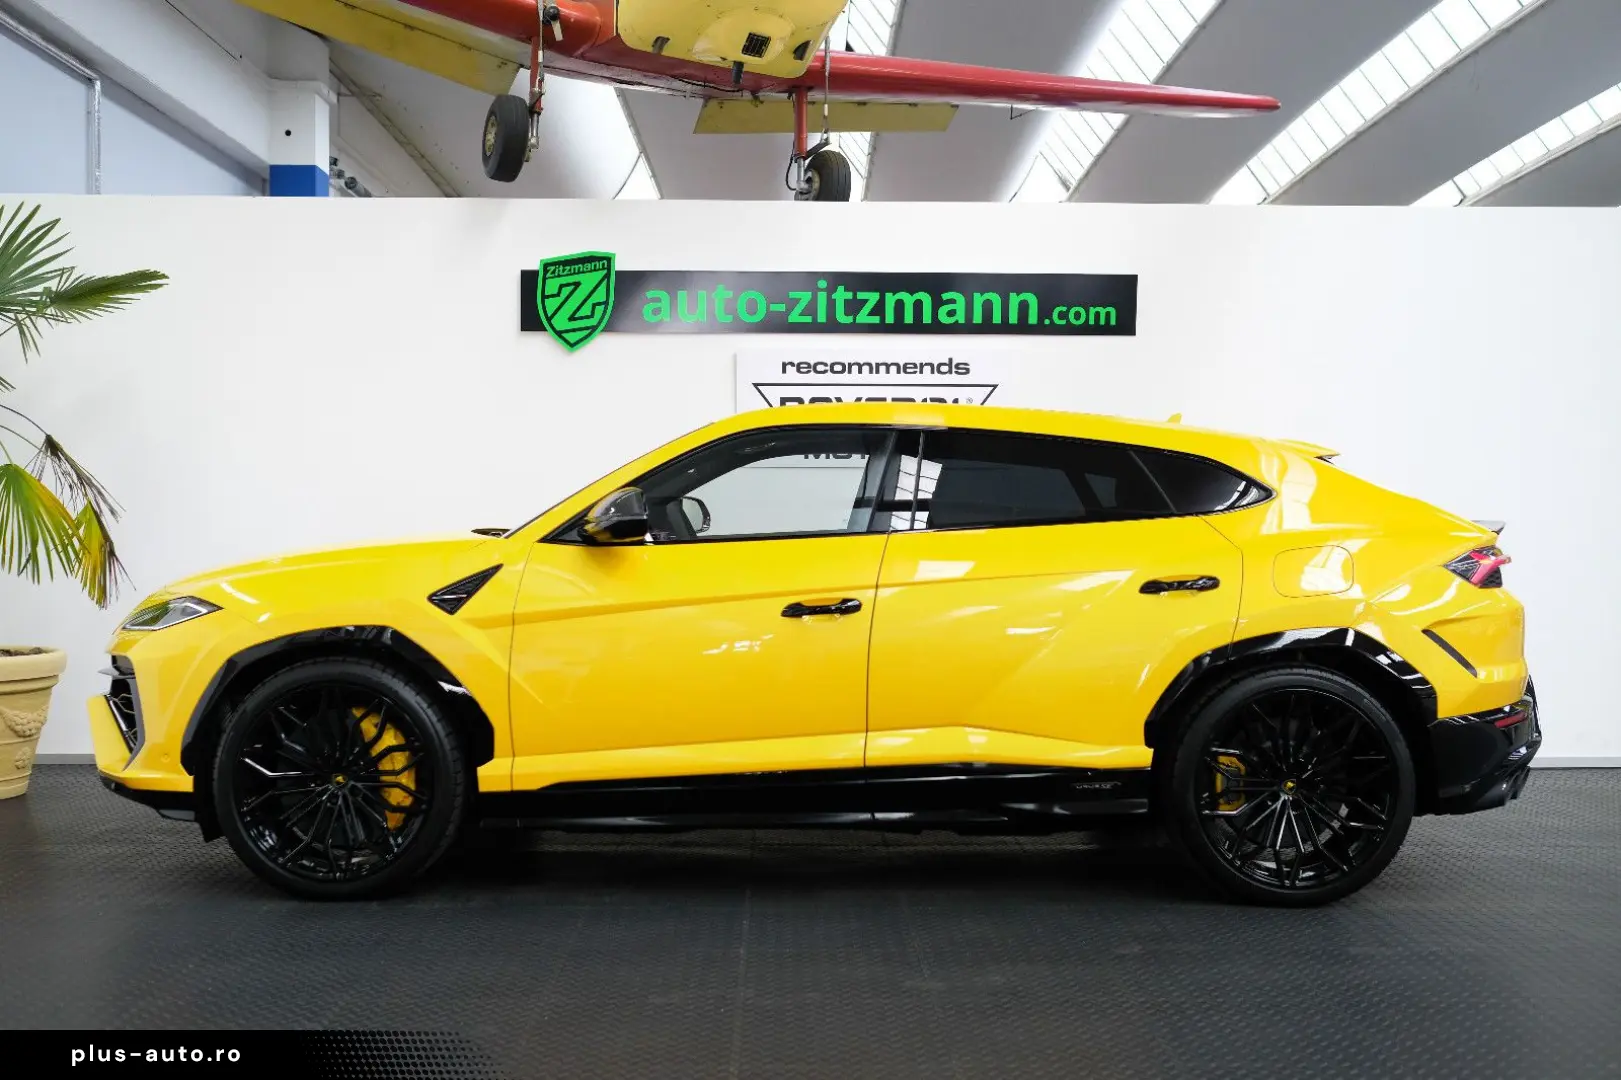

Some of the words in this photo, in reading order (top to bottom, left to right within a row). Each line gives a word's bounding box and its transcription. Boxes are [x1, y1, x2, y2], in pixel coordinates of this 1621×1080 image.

[545, 260, 608, 278] Zitzmann
[642, 280, 1117, 326] auto-zitzmann.com
[781, 357, 971, 376] recommends
